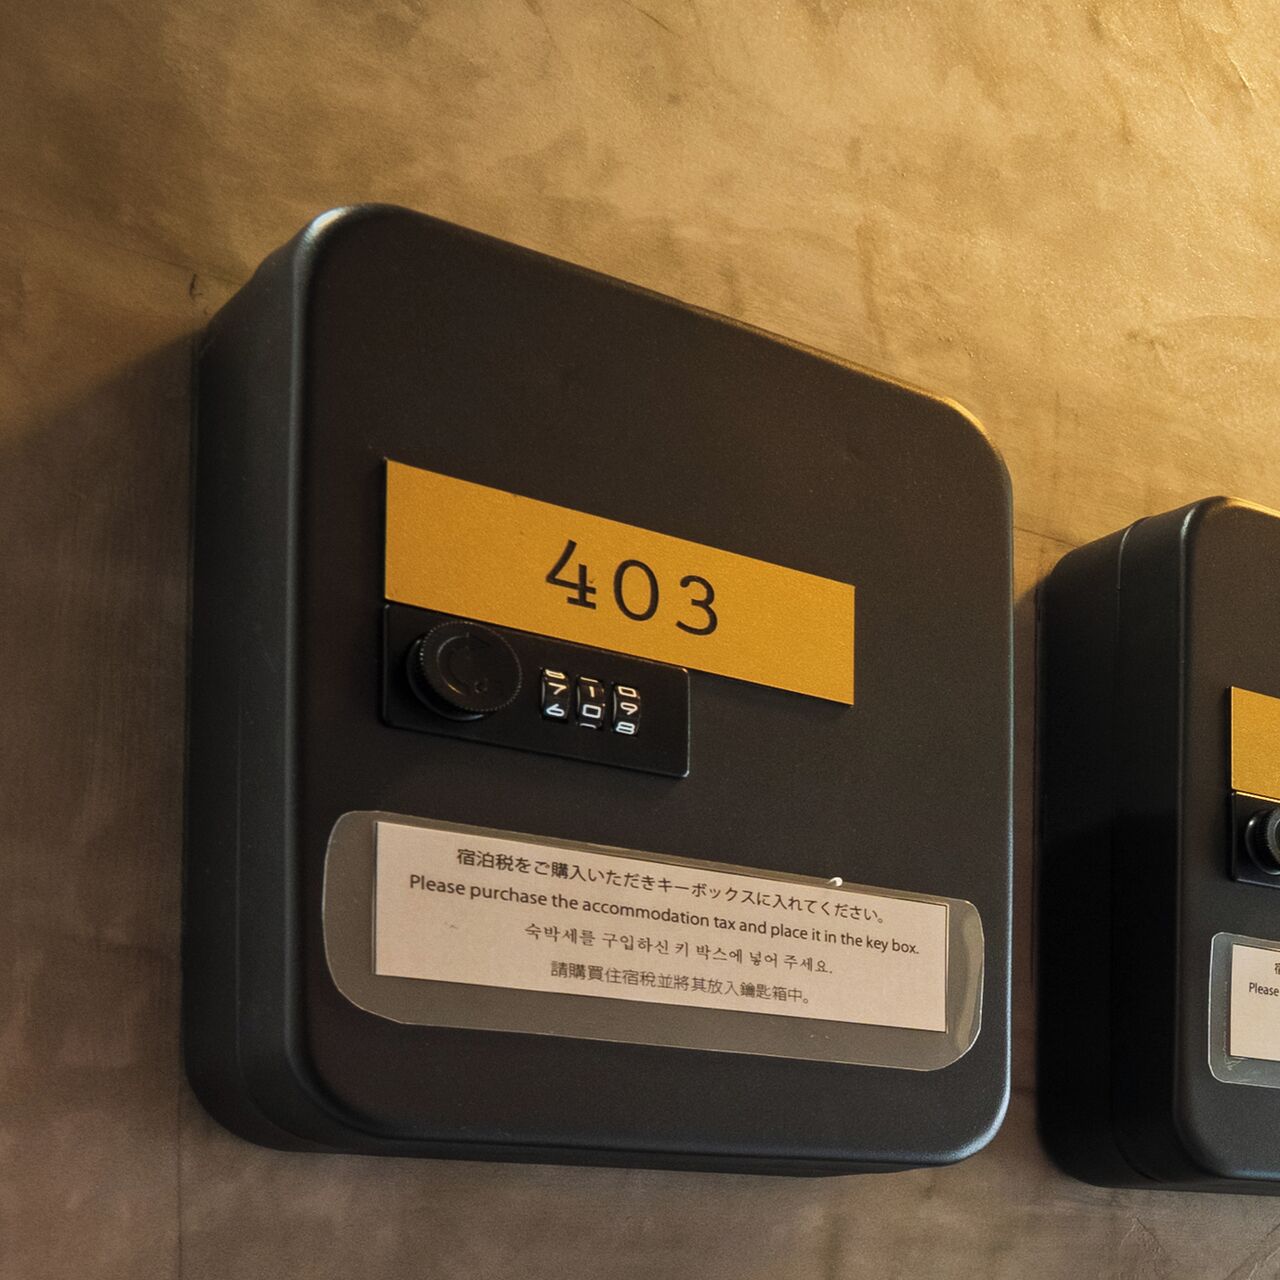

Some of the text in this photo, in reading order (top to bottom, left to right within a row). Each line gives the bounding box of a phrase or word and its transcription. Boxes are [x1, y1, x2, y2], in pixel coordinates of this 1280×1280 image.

[545, 539, 718, 637] 403
[409, 873, 920, 955] Please purchase the accommodation tax and place it in the key box.
[456, 848, 884, 924] 宿泊税をご購入いただきキーボックスに入れてください。
[524, 922, 833, 974] 숙박세를 구입하신 키 박스에 넣어 주세요.
[1248, 981, 1280, 997] Please
